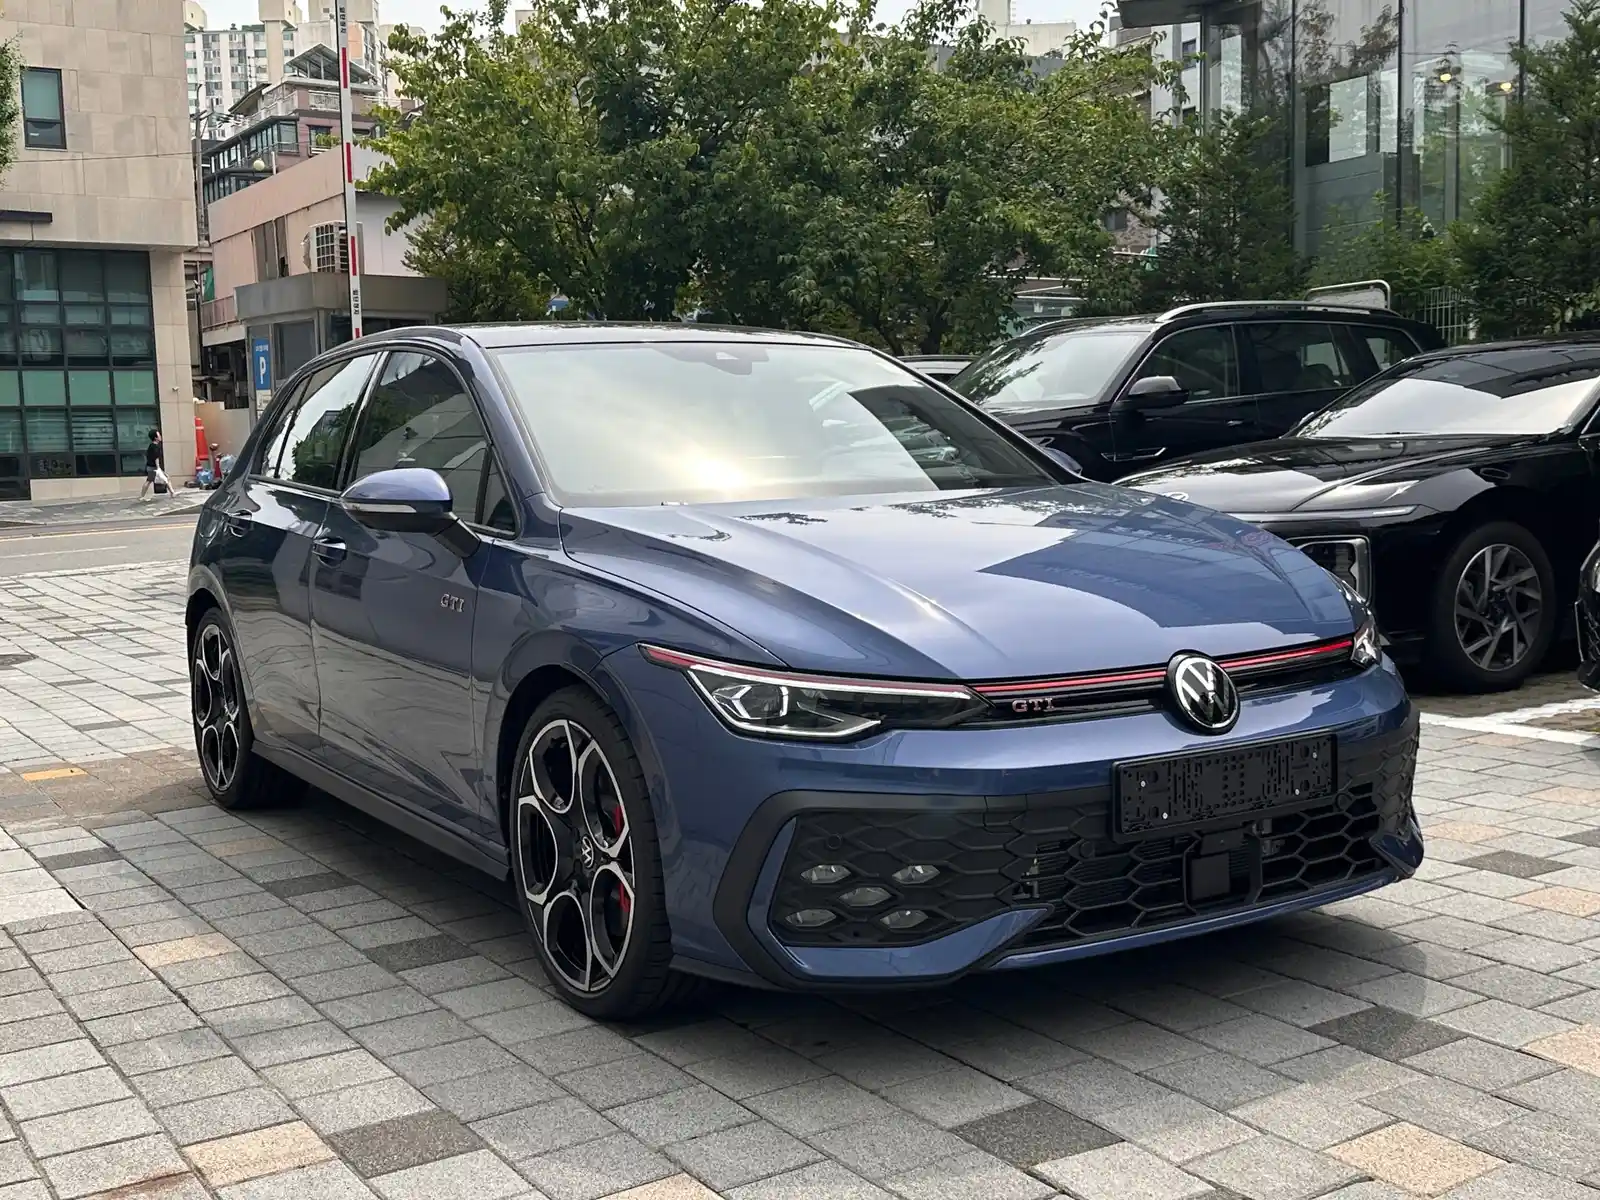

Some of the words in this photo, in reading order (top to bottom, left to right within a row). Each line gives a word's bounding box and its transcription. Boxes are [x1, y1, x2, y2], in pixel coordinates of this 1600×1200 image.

[260, 356, 267, 385] P
[440, 593, 465, 613] GTI
[1012, 697, 1055, 713] GTI
